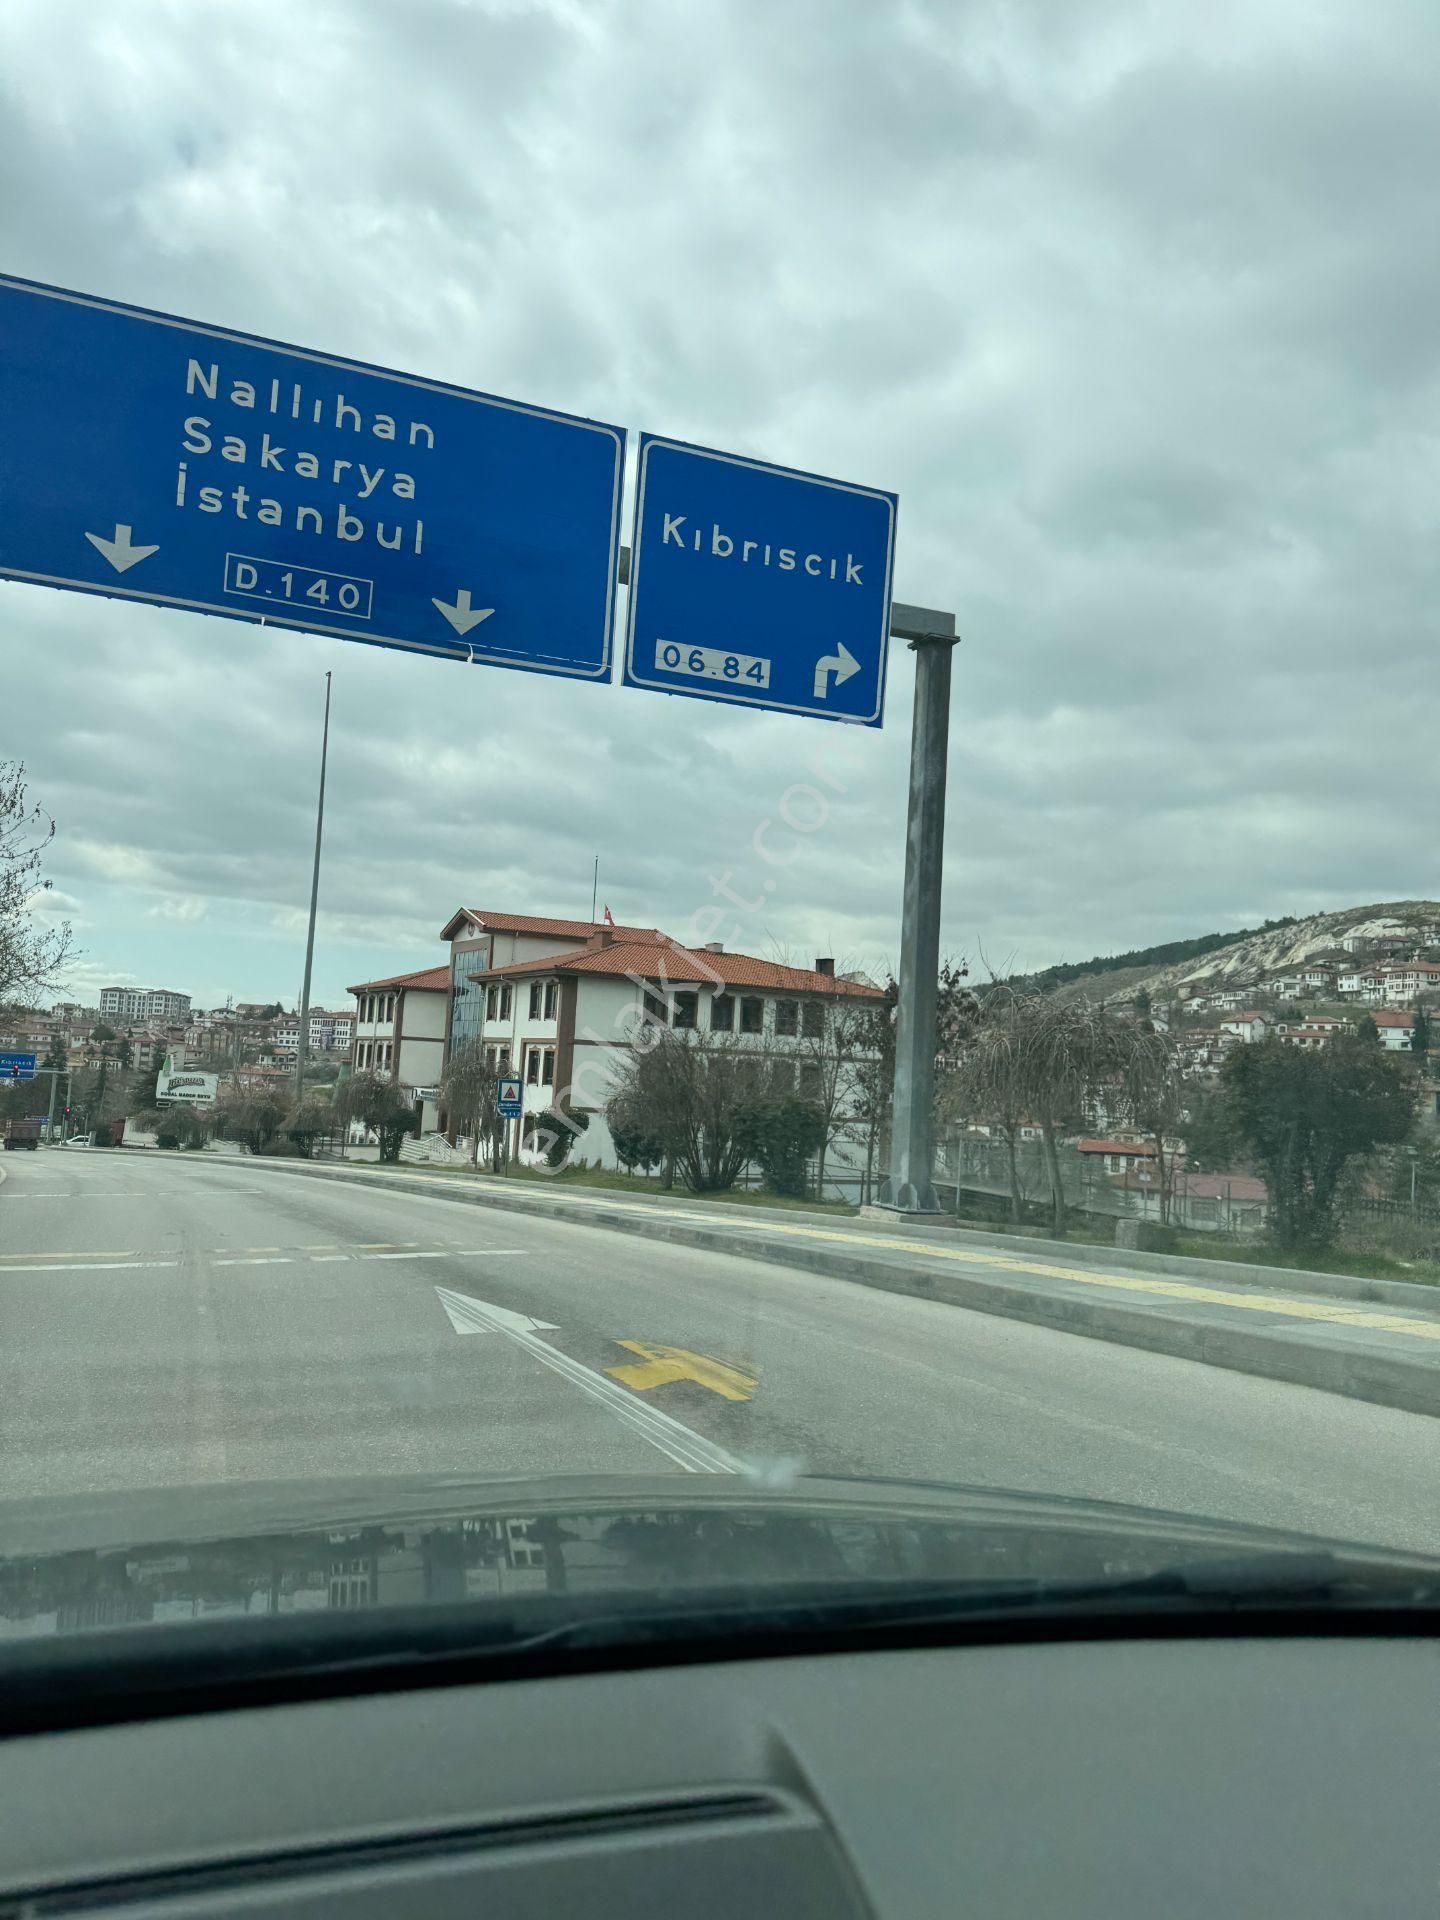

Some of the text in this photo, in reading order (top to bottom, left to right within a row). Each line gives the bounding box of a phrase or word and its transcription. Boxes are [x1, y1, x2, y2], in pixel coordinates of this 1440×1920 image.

[186, 358, 437, 449] Nallıhan
[182, 416, 417, 500] Sakarya
[176, 463, 424, 555] İstanbul
[234, 563, 361, 610] D.140
[662, 513, 864, 585] Kıbrıscık
[663, 645, 765, 684] 06.84
